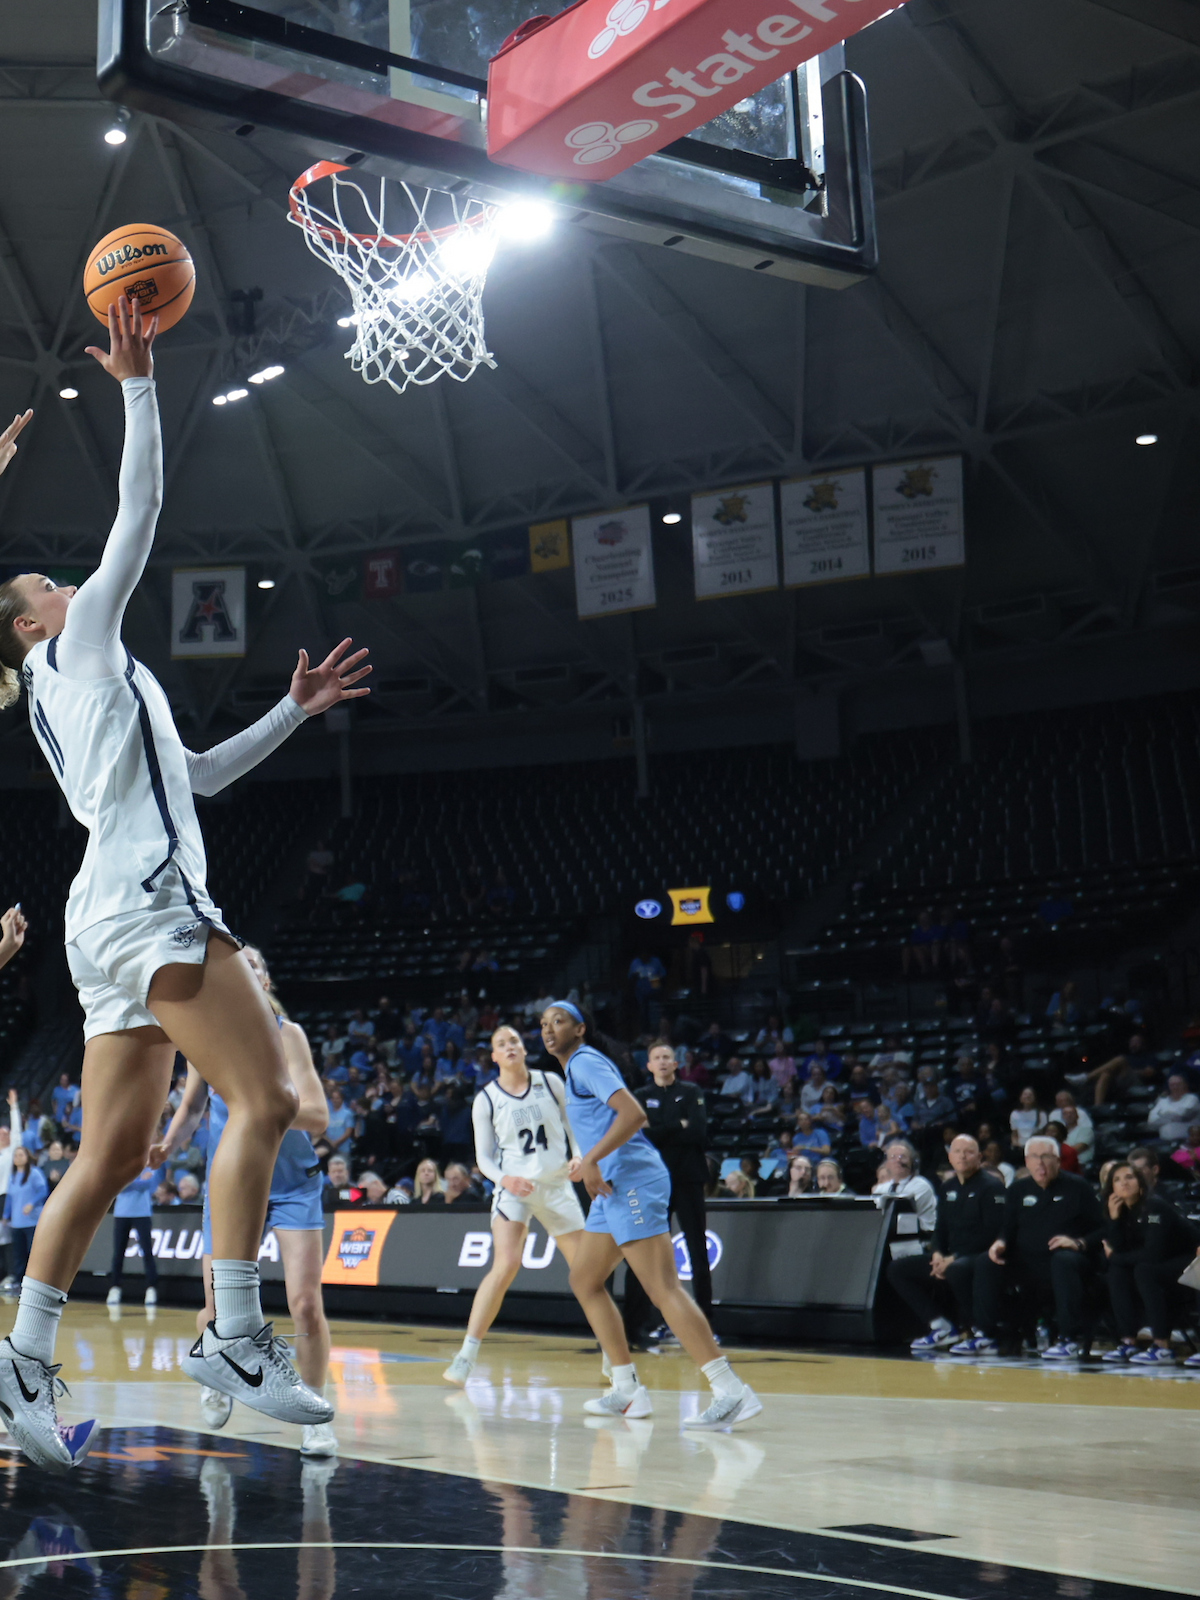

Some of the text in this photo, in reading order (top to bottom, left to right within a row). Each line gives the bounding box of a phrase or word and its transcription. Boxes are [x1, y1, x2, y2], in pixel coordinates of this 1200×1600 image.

[95, 243, 168, 276] Wilson
[128, 286, 156, 299] WBIT
[902, 545, 936, 562] 2015
[811, 556, 843, 574] 2014
[721, 568, 753, 586] 2013
[601, 588, 633, 606] 2025
[179, 581, 237, 643] A
[34, 698, 65, 779] 11
[511, 1104, 543, 1127] BYU
[518, 1124, 549, 1156] 24
[340, 1241, 372, 1254] WBIT
[457, 1231, 558, 1269] BU
